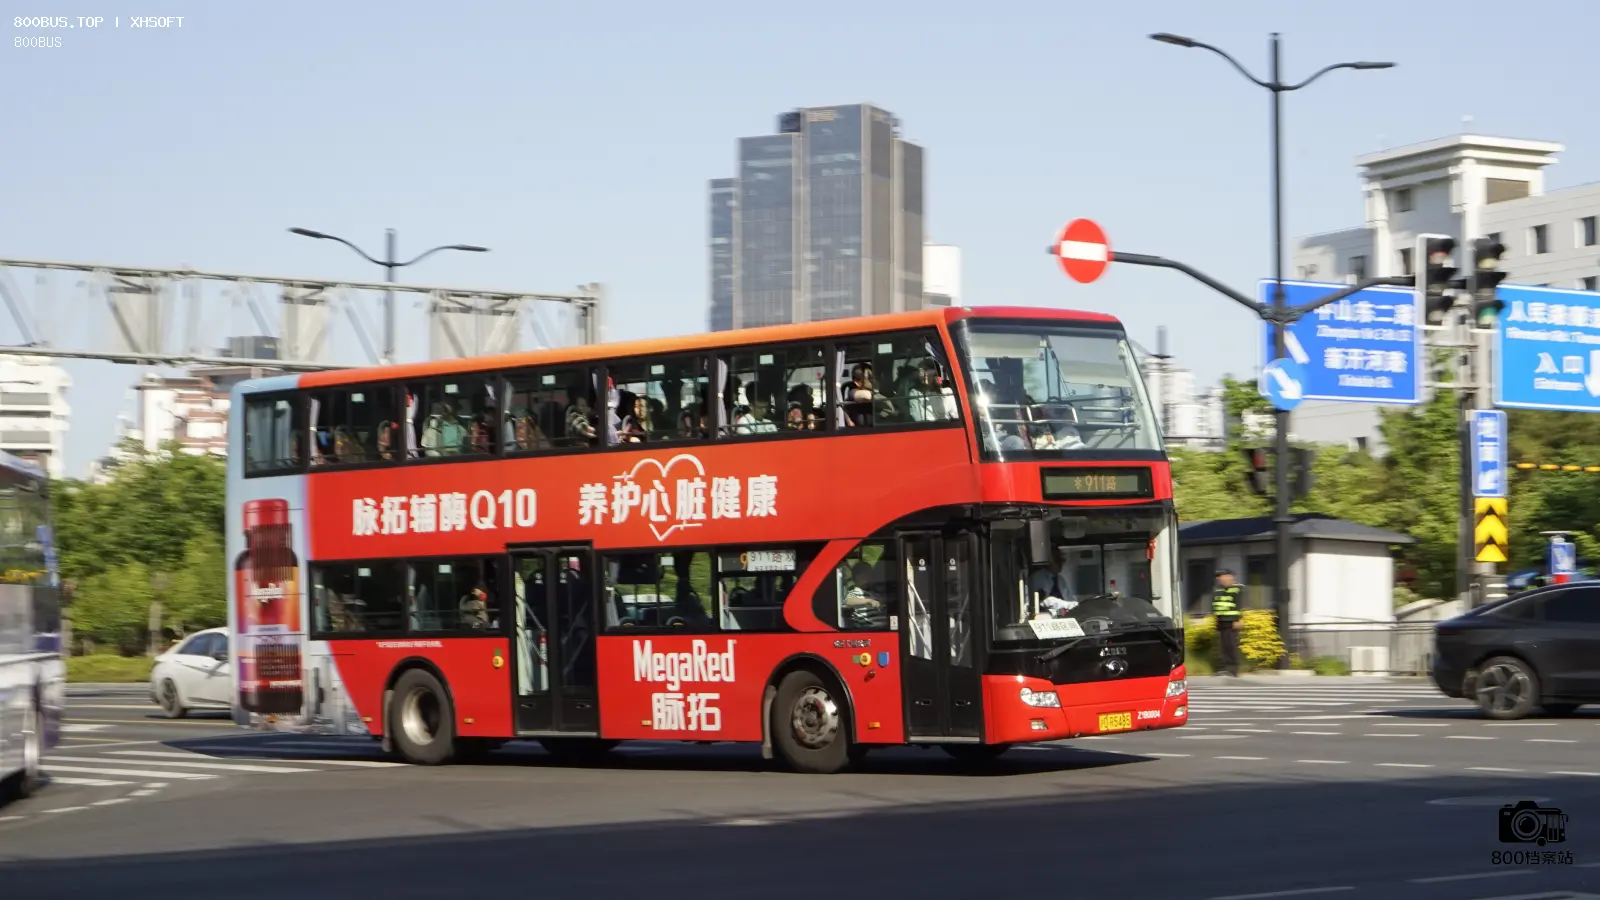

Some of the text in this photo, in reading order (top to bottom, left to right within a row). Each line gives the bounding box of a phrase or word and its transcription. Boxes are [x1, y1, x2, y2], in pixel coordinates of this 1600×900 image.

[352, 488, 537, 536] 脉拓辅酶Q10
[578, 474, 778, 526] 养护心脏健康
[632, 638, 735, 692] MegaRed
[650, 692, 722, 732] 脉拓
